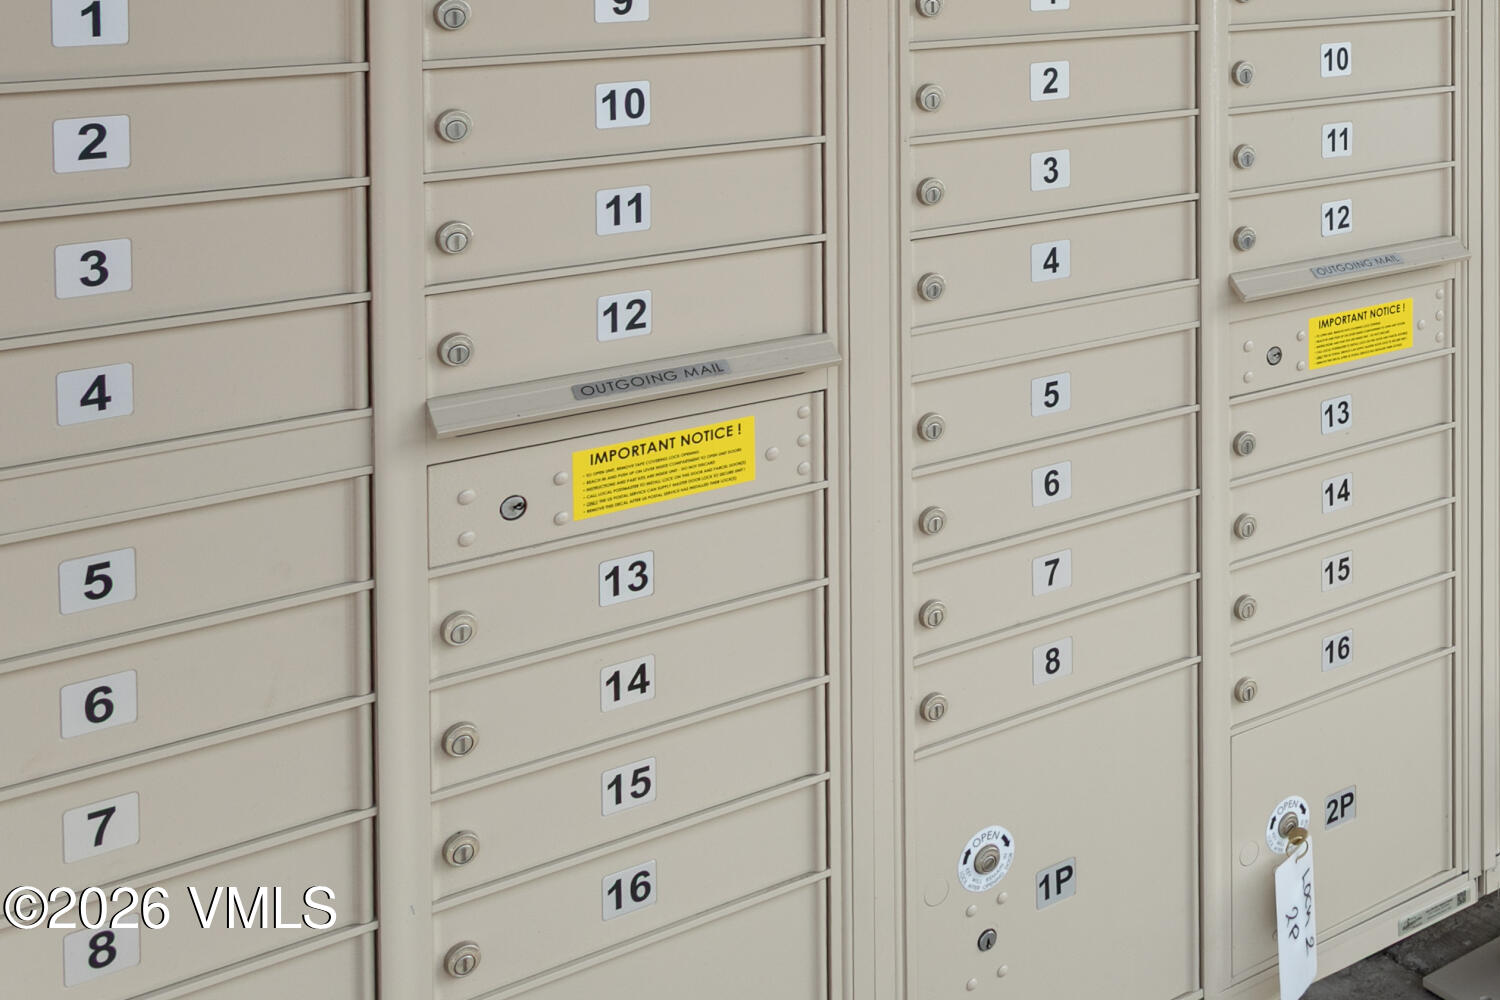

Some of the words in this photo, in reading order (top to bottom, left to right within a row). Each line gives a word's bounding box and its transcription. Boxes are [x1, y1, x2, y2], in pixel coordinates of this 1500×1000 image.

[79, 0, 102, 39] 1
[1323, 47, 1349, 72] 10
[1042, 67, 1058, 95] 2
[600, 86, 646, 122] 10
[76, 121, 109, 162] 2
[1327, 127, 1348, 152] 11
[1043, 156, 1059, 184] 3
[604, 191, 643, 227] 11
[1324, 205, 1350, 231] 12
[78, 248, 110, 288] 3
[1042, 246, 1060, 274] 4
[1316, 259, 1373, 276] OUTGOING
[1375, 254, 1401, 265] MAIL
[602, 297, 648, 334] 12
[1318, 310, 1368, 329] IMPORTANT
[1370, 304, 1401, 318] NOTICE
[78, 373, 113, 412] 4
[580, 370, 678, 396] OUTGOING
[683, 362, 725, 378] MAIL
[1044, 380, 1060, 408] 5
[1324, 400, 1350, 428] 13
[589, 437, 677, 466] IMPORTANT
[680, 426, 734, 447] NOTICE
[737, 423, 742, 435] !
[1044, 469, 1060, 497] 6
[1324, 478, 1351, 507] 14
[82, 559, 114, 602] 5
[603, 559, 650, 598] 13
[1044, 557, 1060, 586] 7
[1324, 556, 1350, 585] 15
[1045, 647, 1061, 675] 8
[1325, 635, 1350, 664] 16
[604, 661, 652, 703] 14
[83, 684, 115, 725] 6
[606, 764, 653, 807] 15
[1277, 799, 1299, 816] OPEN
[1326, 792, 1354, 825] 2P
[86, 805, 117, 848] 7
[972, 830, 1001, 848] OPEN
[606, 869, 652, 912] 16
[1038, 865, 1074, 901] 1P
[1285, 906, 1300, 940] 2P
[87, 929, 118, 970] 8
[1305, 936, 1315, 958] 2
